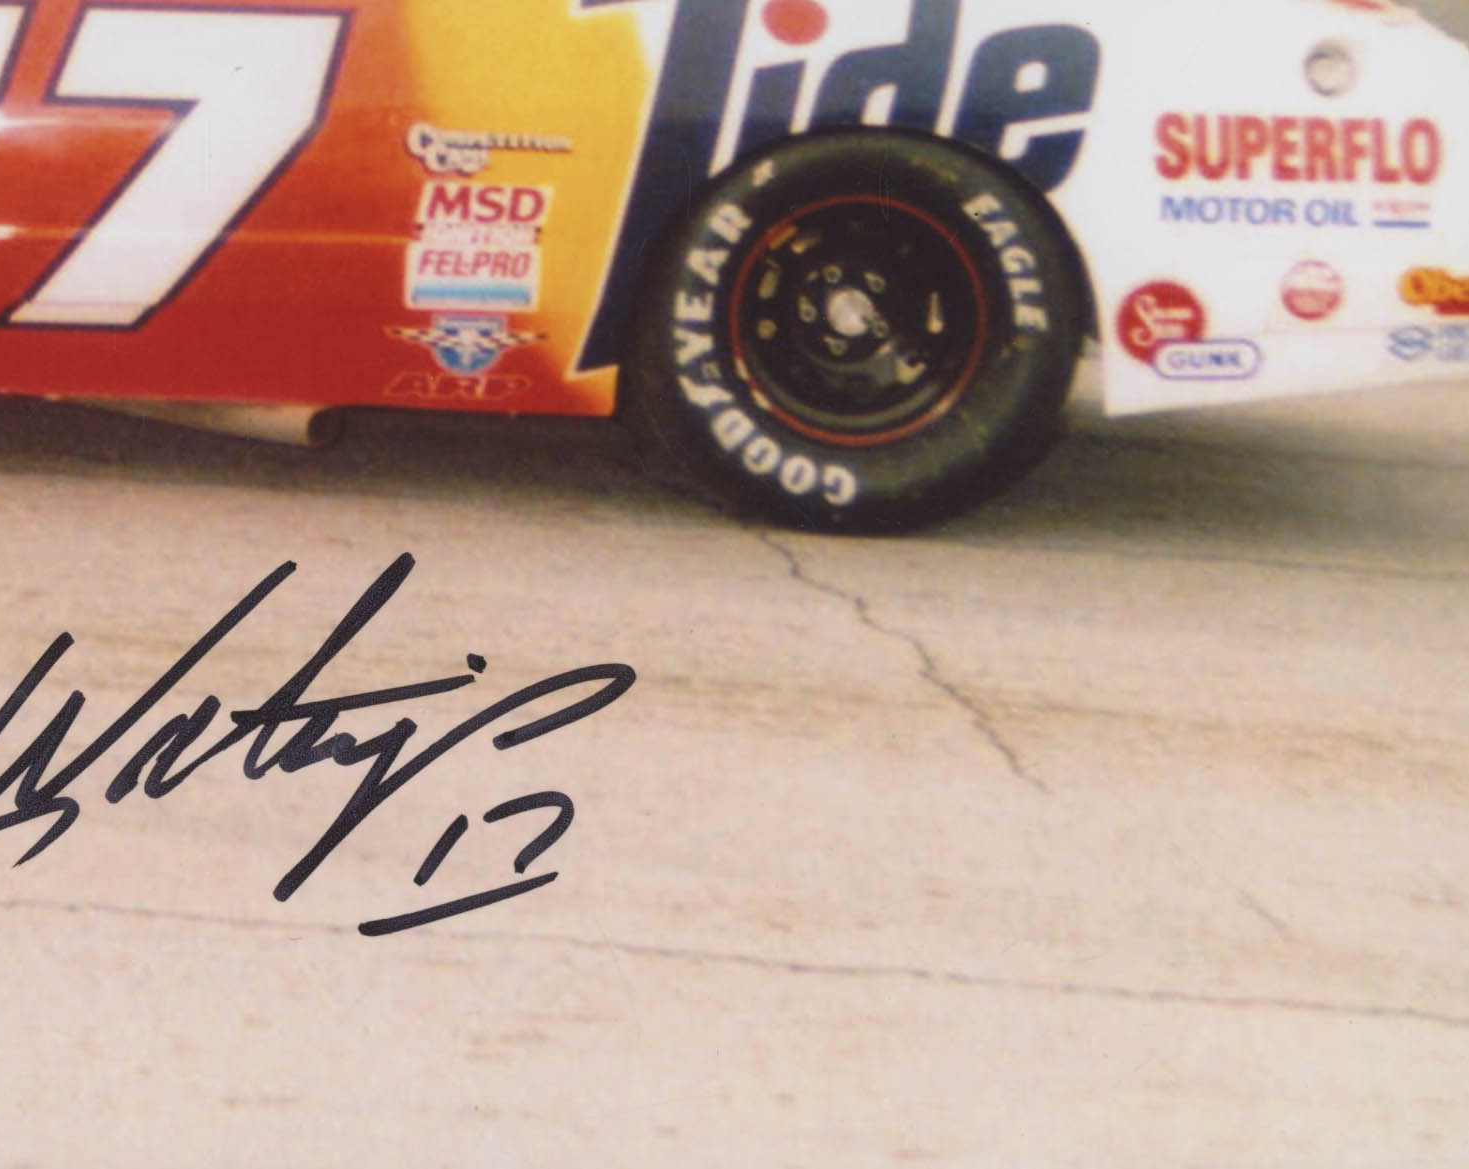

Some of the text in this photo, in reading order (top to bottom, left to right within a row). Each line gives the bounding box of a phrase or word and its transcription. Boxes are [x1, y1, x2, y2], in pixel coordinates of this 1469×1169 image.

[1154, 112, 1443, 184] SUPERFLO
[427, 185, 545, 223] MSD
[1160, 195, 1296, 225] MOTOR
[1303, 198, 1360, 228] OIL
[962, 193, 1050, 331] EAGLE
[673, 202, 857, 507] GOODYEAR
